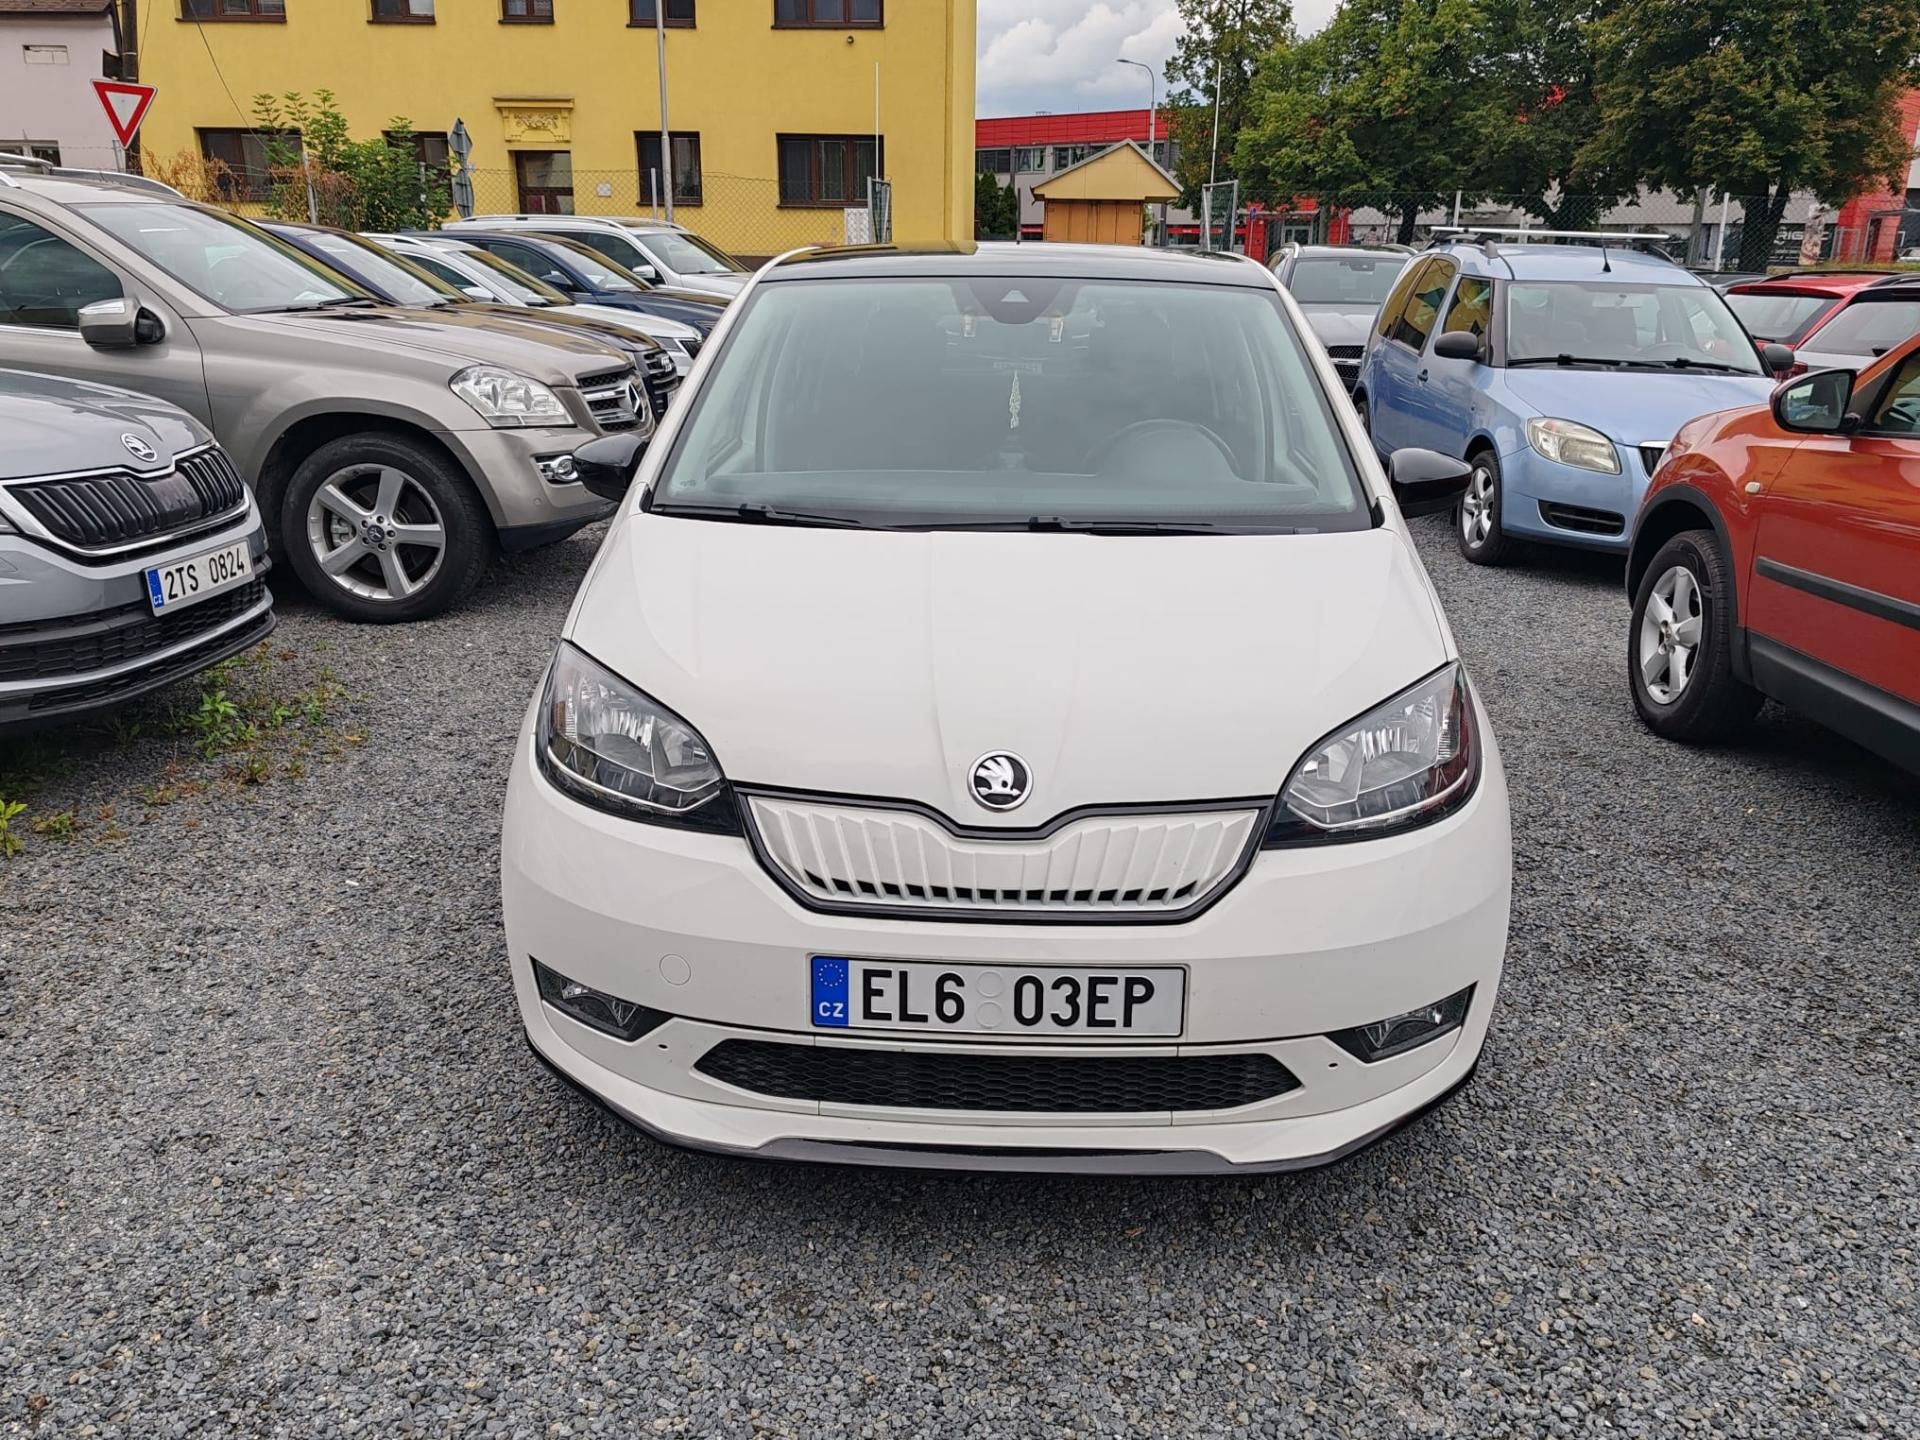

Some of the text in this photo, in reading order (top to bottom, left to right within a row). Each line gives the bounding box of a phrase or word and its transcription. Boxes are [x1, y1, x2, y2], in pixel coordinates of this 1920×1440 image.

[165, 548, 244, 600] 2TS 0824
[153, 594, 162, 605] CZ
[818, 1001, 844, 1018] CZ
[863, 969, 1154, 1027] EL6 03EP
